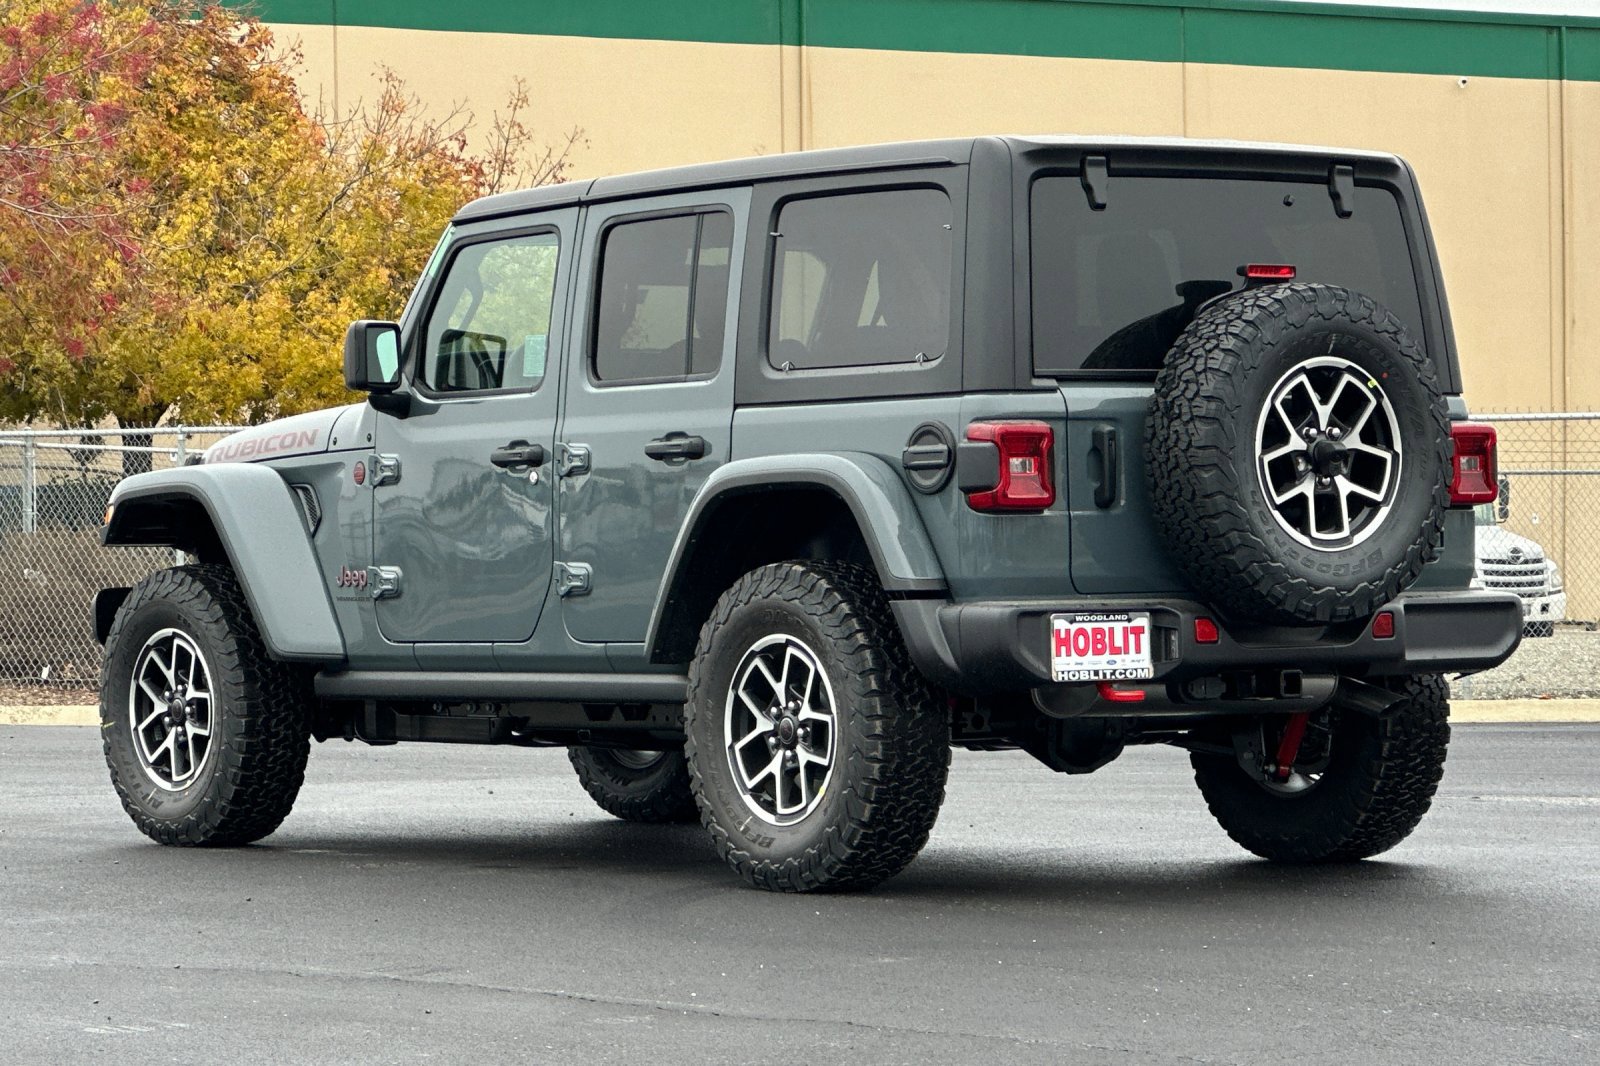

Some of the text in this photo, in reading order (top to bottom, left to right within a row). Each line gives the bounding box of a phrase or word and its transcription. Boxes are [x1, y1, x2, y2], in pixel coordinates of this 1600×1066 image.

[205, 428, 320, 464] RUBICON
[336, 566, 368, 592] Jeep
[1074, 614, 1128, 622] WOODLAND
[1054, 626, 1145, 657] HOBLIT
[1057, 668, 1149, 681] HOBLIT.COM
